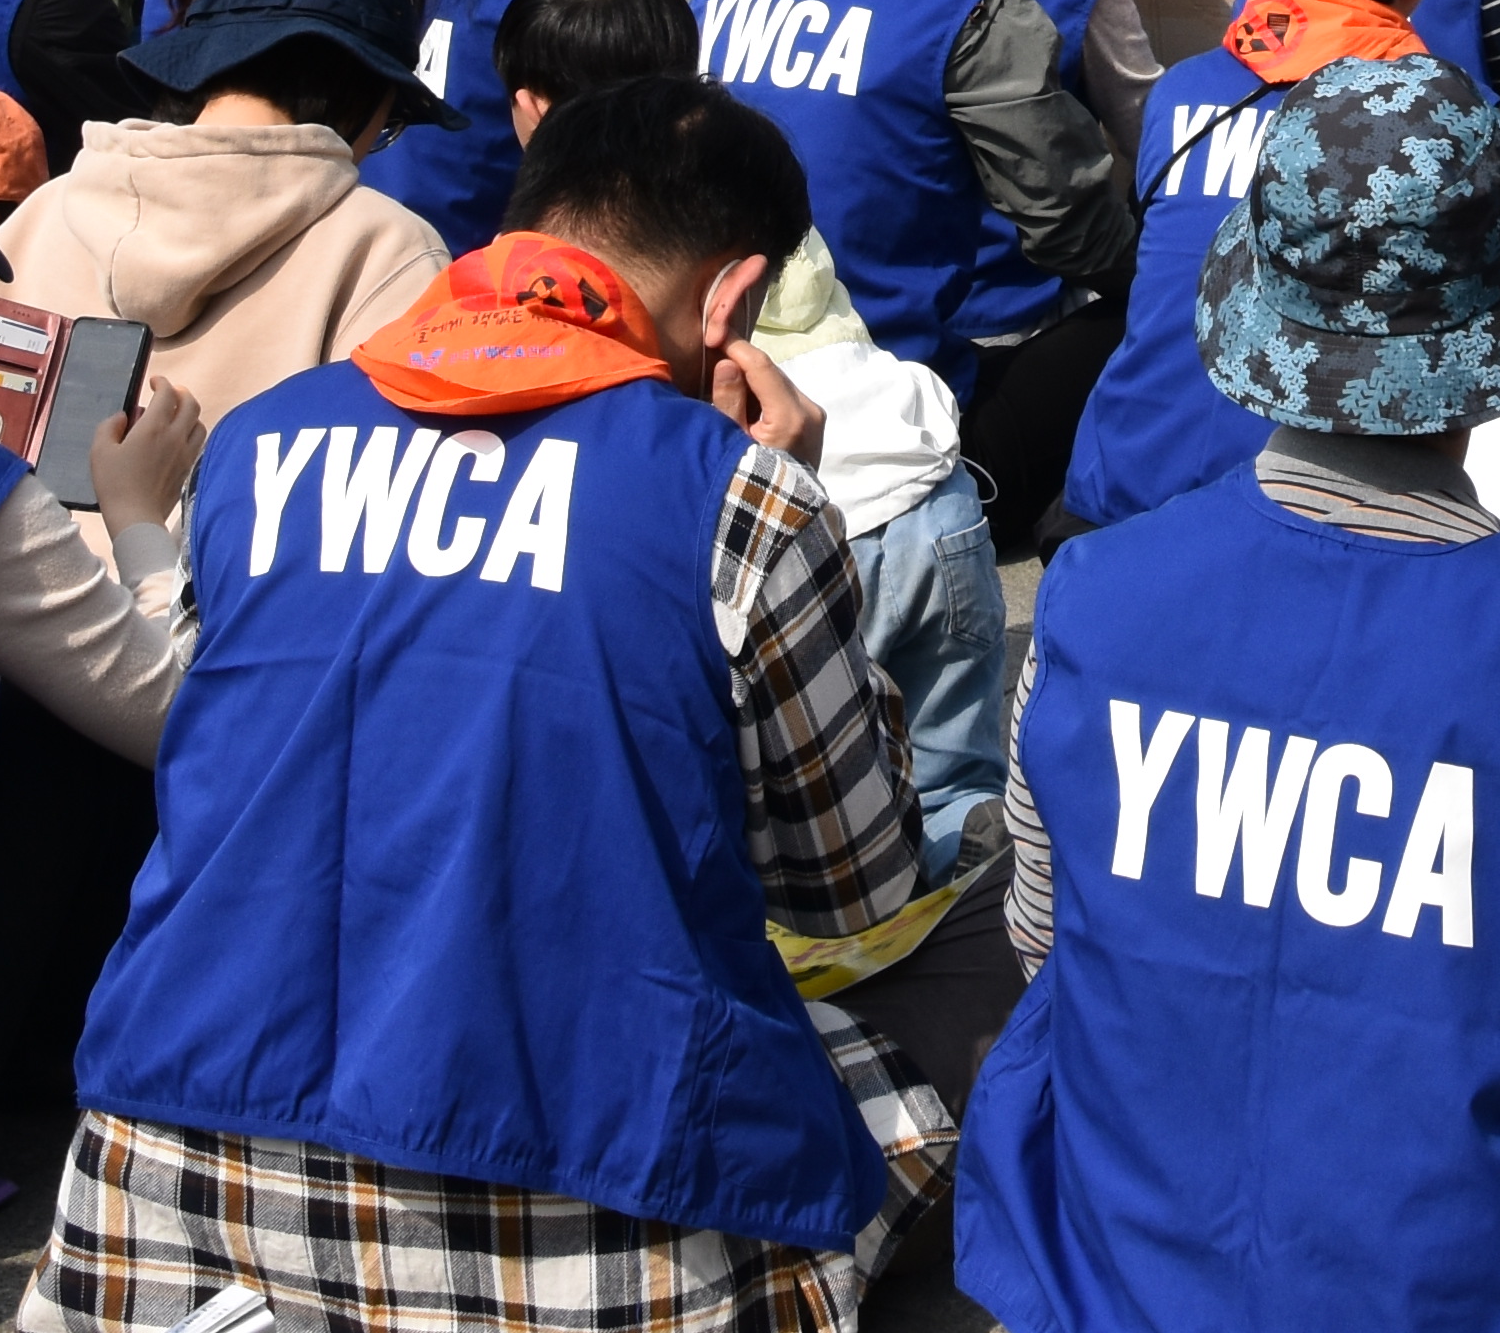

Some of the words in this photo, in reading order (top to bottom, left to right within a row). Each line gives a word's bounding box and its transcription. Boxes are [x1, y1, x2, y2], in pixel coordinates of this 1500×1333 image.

[1165, 104, 1272, 199] YW
[248, 426, 579, 593] YWCA
[1108, 698, 1476, 948] YWCA
